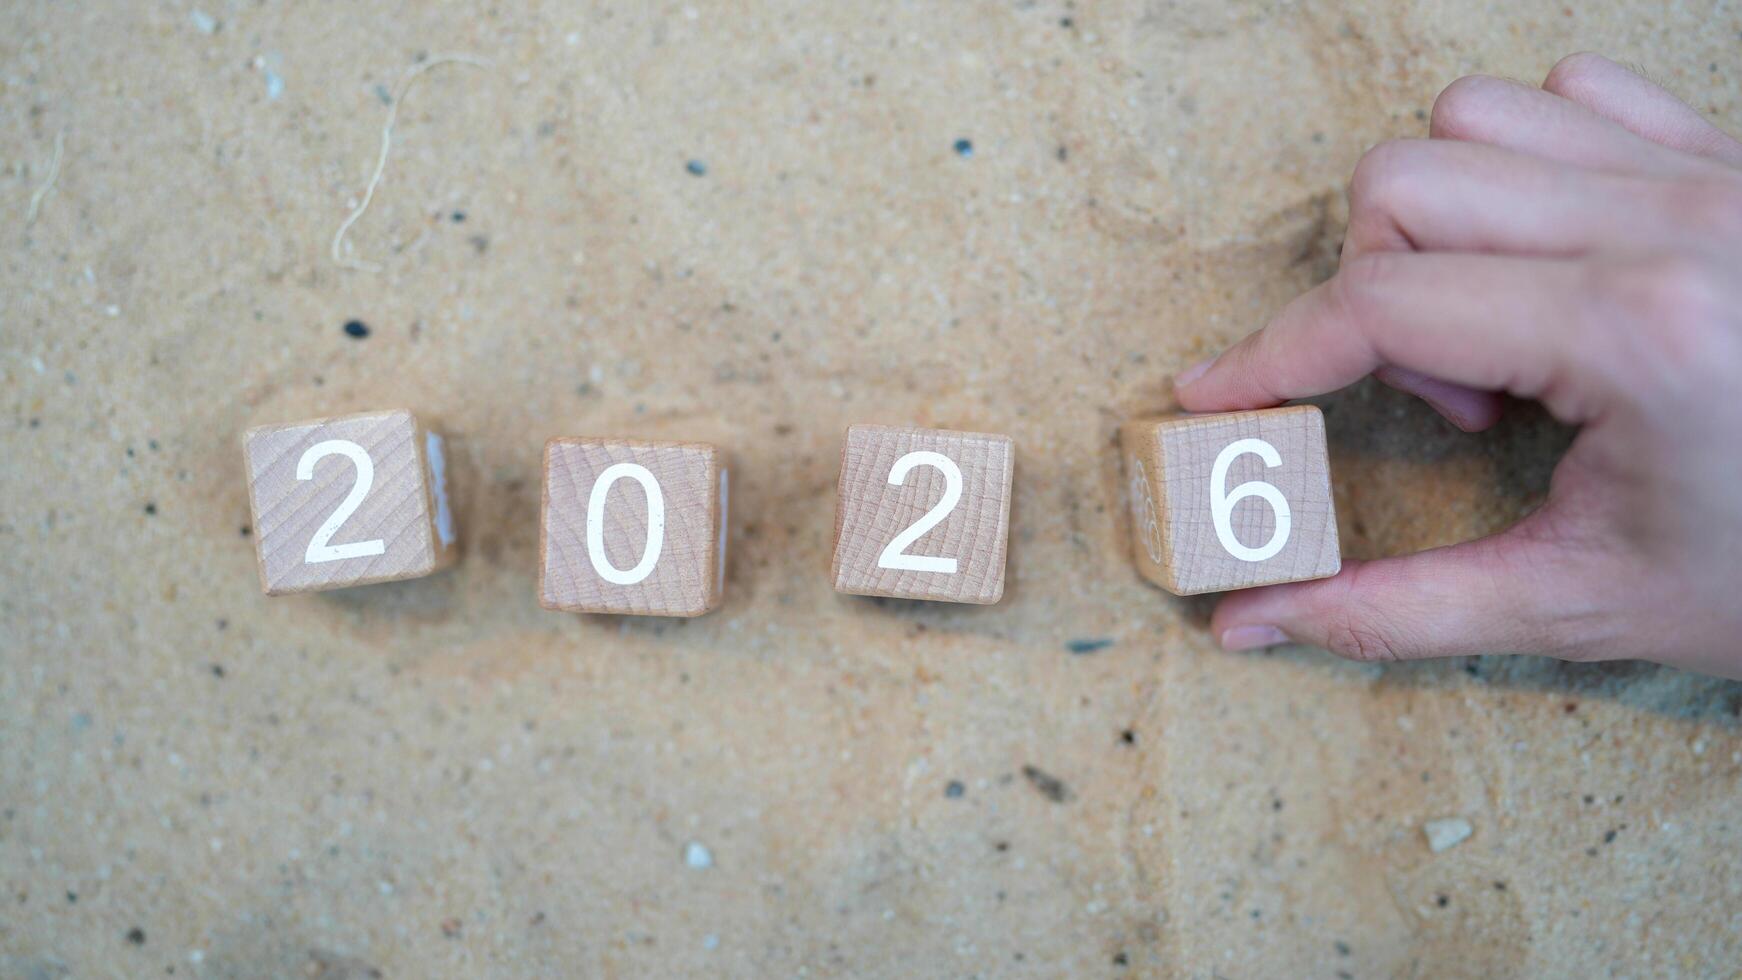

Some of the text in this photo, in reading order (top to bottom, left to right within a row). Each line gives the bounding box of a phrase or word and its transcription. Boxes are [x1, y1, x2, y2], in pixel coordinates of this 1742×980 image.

[296, 439, 1291, 585] 2 0 2 6
